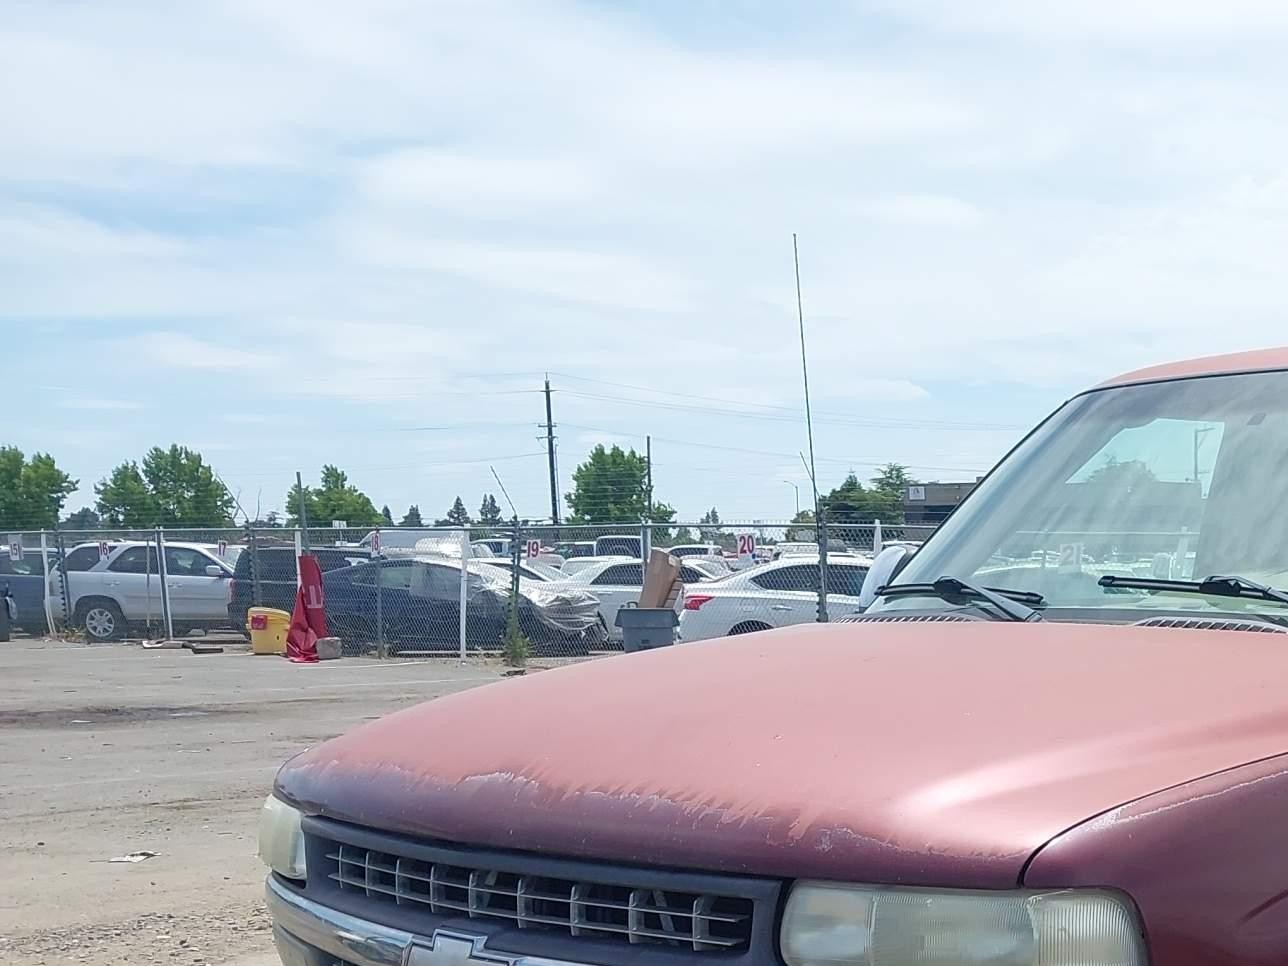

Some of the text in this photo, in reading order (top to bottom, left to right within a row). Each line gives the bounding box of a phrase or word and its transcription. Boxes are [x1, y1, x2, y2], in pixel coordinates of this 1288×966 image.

[99, 541, 108, 556] 16
[218, 541, 227, 556] 17
[527, 541, 539, 557] 19
[739, 535, 754, 554] 20
